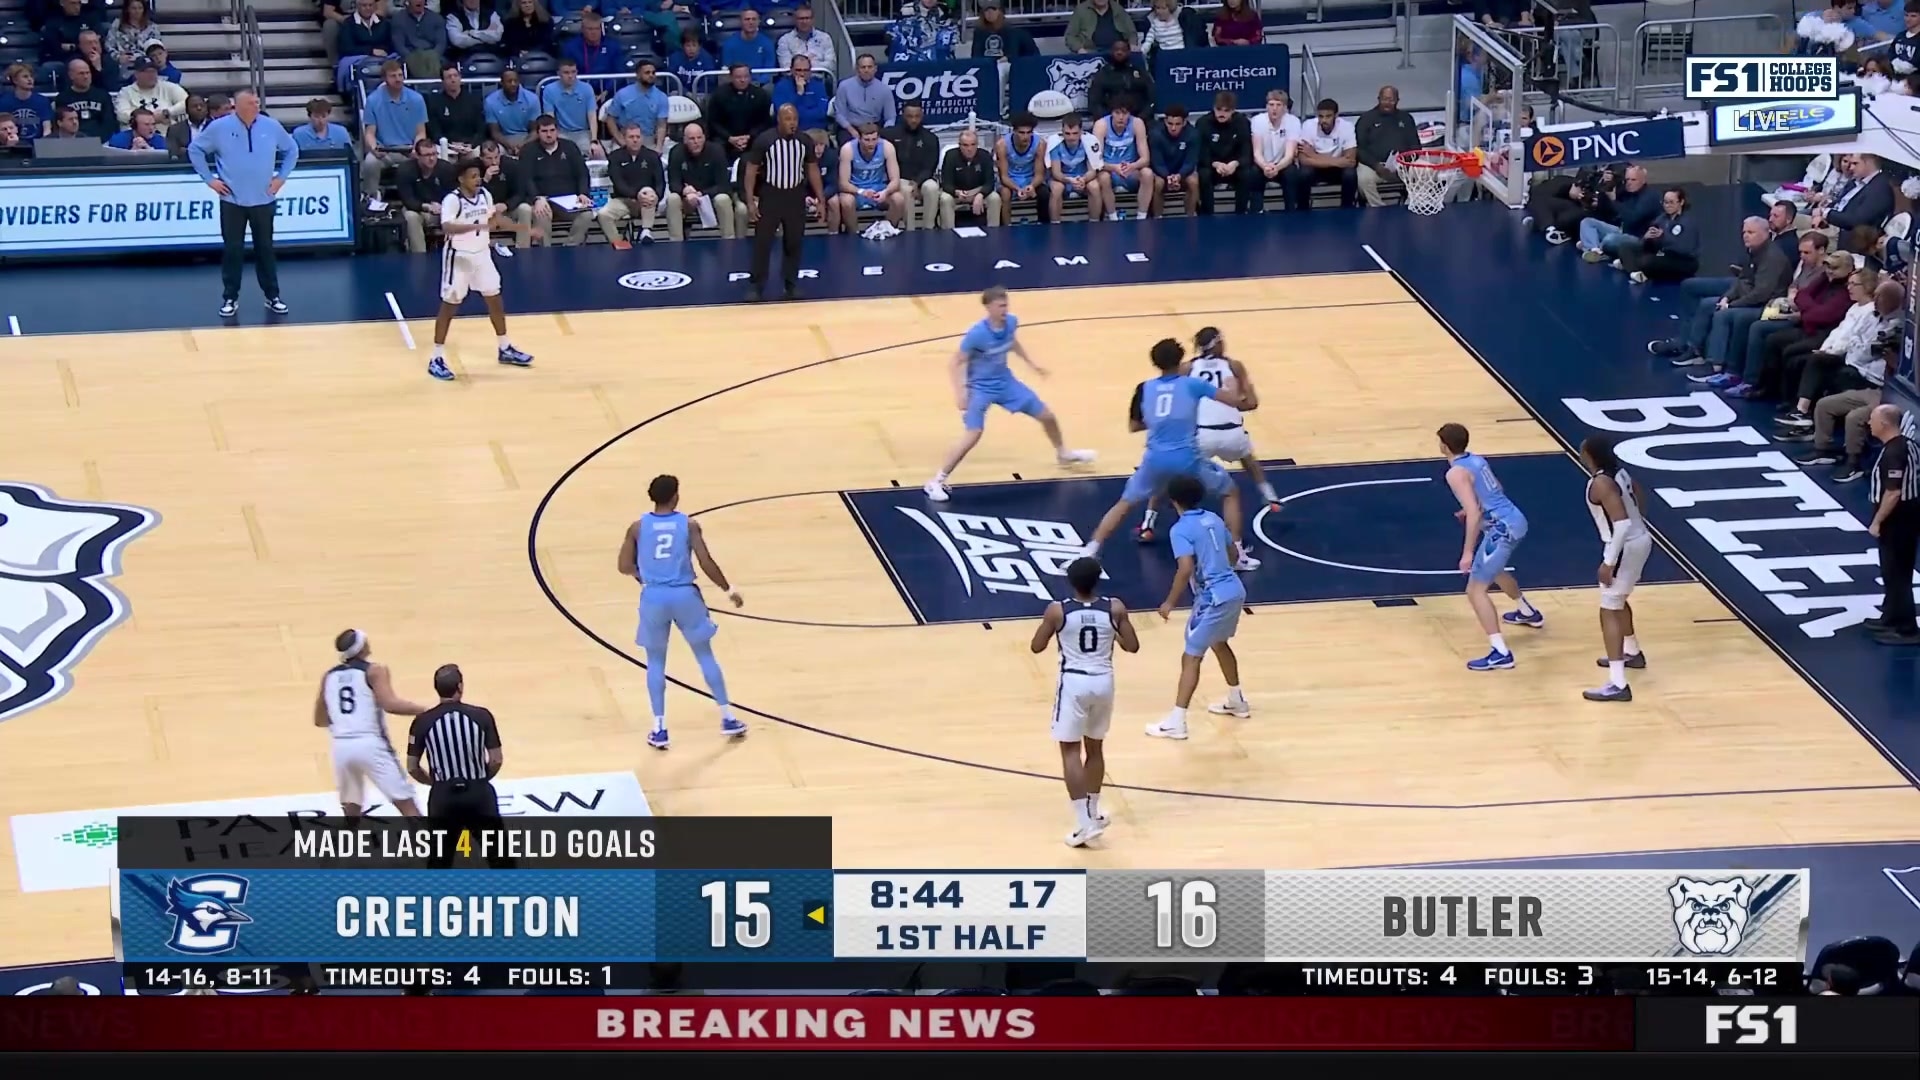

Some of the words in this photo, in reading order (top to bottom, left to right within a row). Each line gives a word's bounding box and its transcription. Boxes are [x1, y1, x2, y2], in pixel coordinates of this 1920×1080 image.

[882, 68, 979, 100] Forté
[1195, 81, 1245, 91] HEALTH
[1196, 66, 1277, 79] Franciscan
[1571, 131, 1640, 160] PNC
[88, 203, 128, 223] FOR
[135, 201, 214, 221] BUTLER
[274, 195, 330, 217] ETICS
[1155, 393, 1174, 417] 0
[654, 533, 673, 559] 2
[937, 511, 1054, 601] EAST
[1079, 626, 1098, 653] 0
[339, 686, 355, 714] 8
